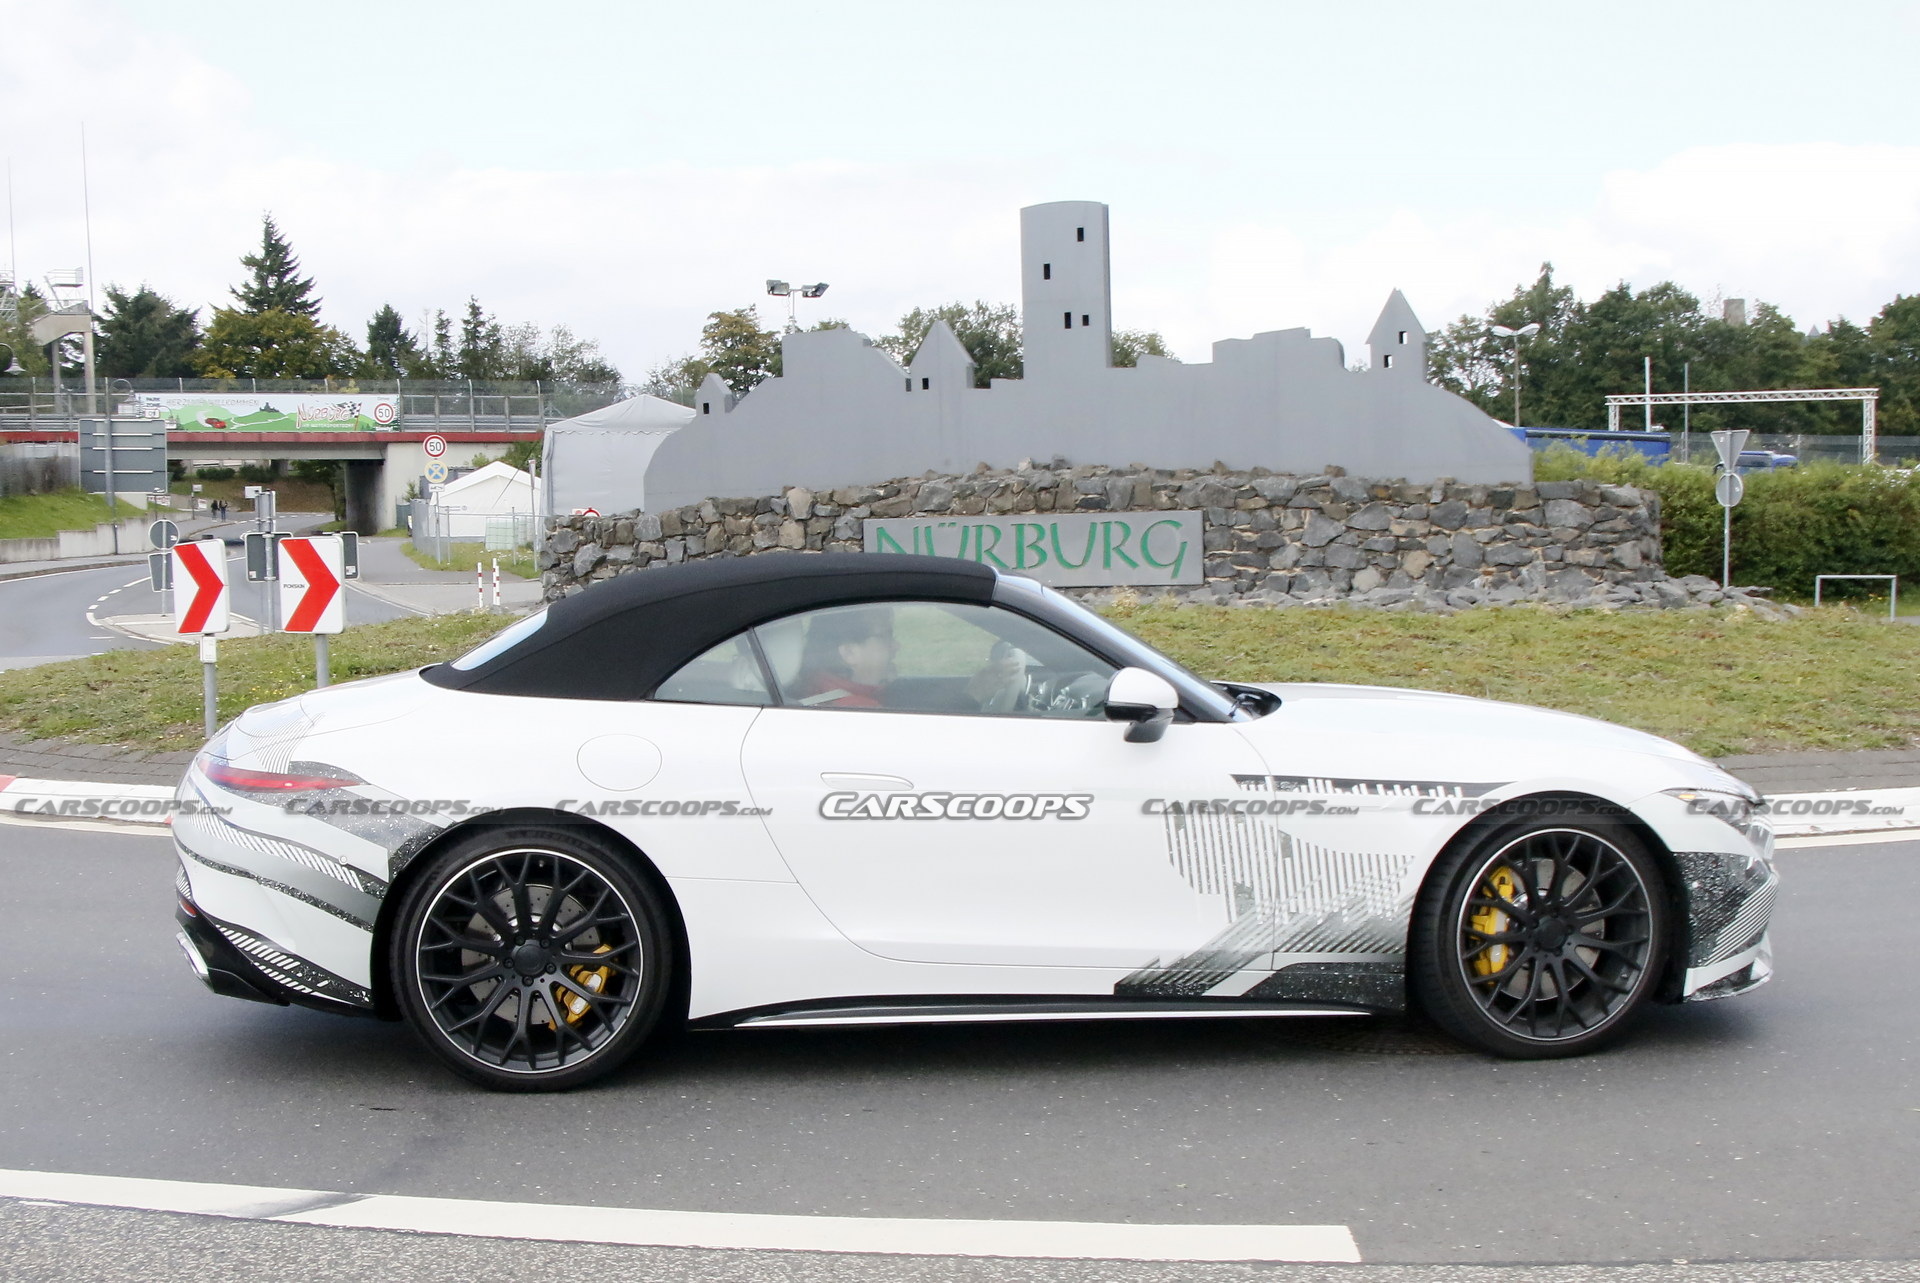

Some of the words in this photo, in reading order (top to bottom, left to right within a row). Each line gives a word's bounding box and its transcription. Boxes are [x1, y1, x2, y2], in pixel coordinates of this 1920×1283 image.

[378, 408, 391, 418] 50
[429, 442, 442, 451] 50
[876, 519, 1188, 579] NÜRBURG
